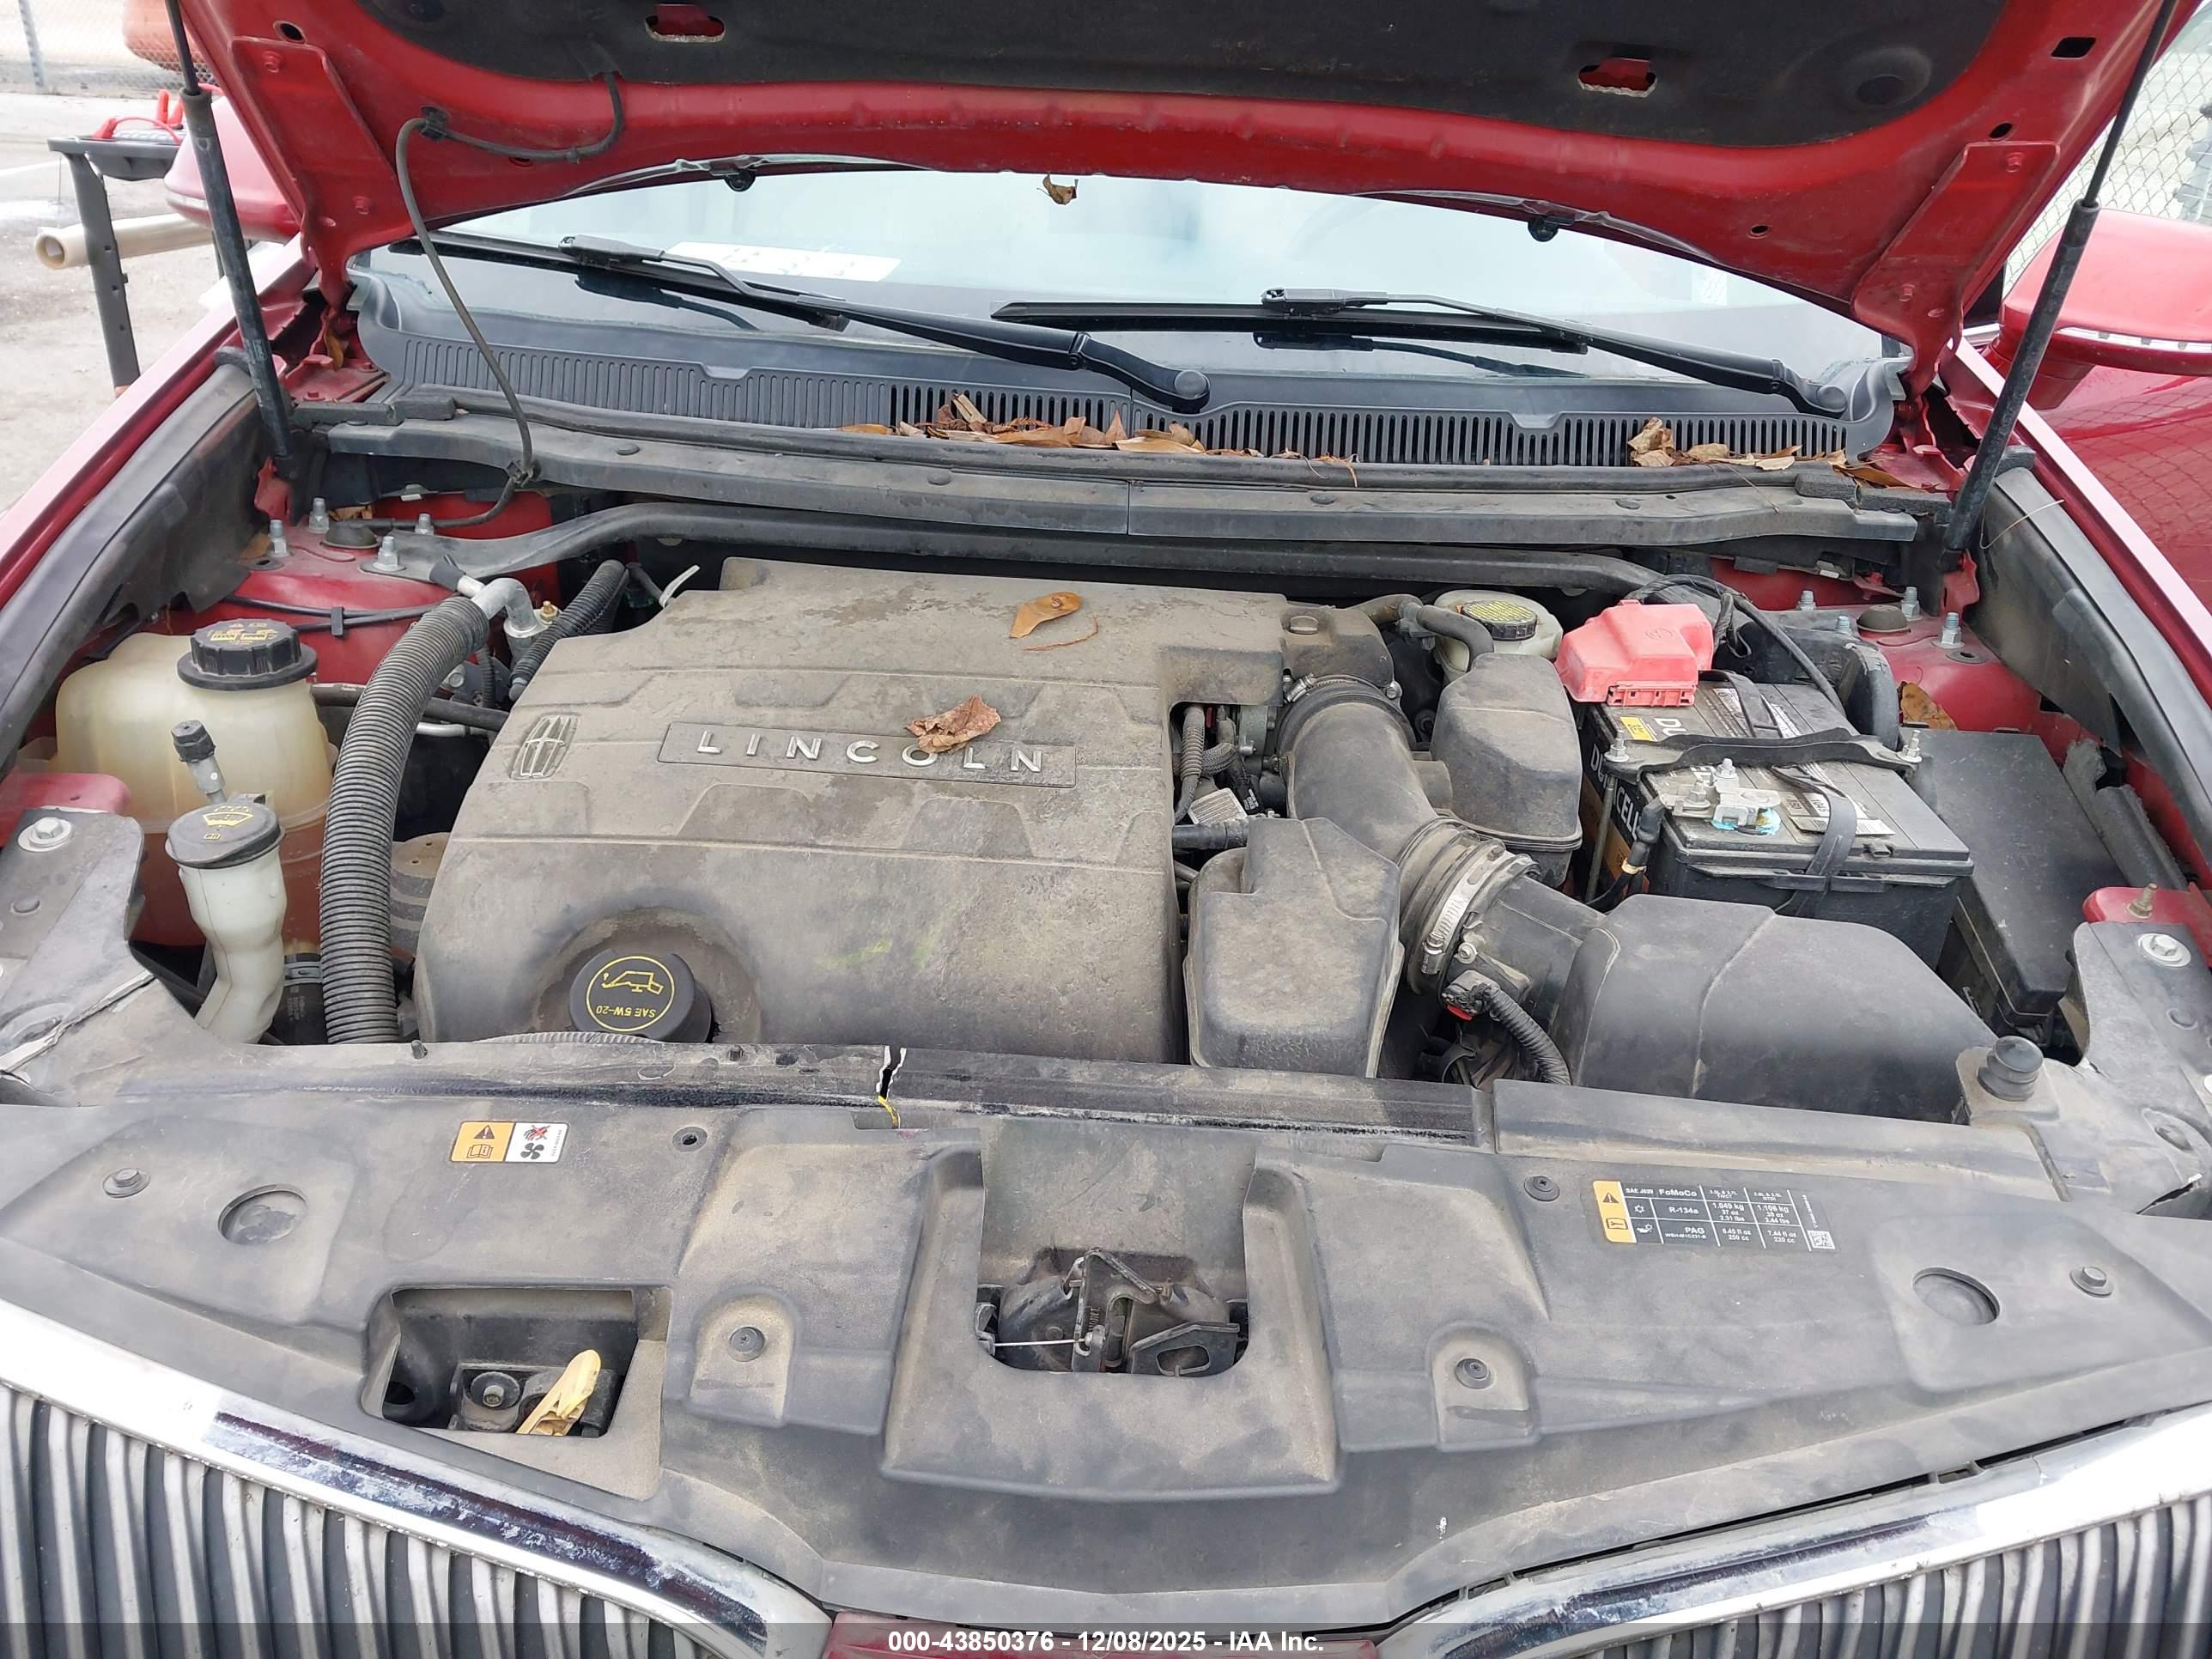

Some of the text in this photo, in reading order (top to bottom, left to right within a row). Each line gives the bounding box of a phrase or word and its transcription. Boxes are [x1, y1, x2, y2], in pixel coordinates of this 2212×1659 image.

[696, 729, 1043, 772] LINCOLN
[596, 1006, 656, 1018] SAE 5W-20
[1658, 1188, 1698, 1197] FoMoCo
